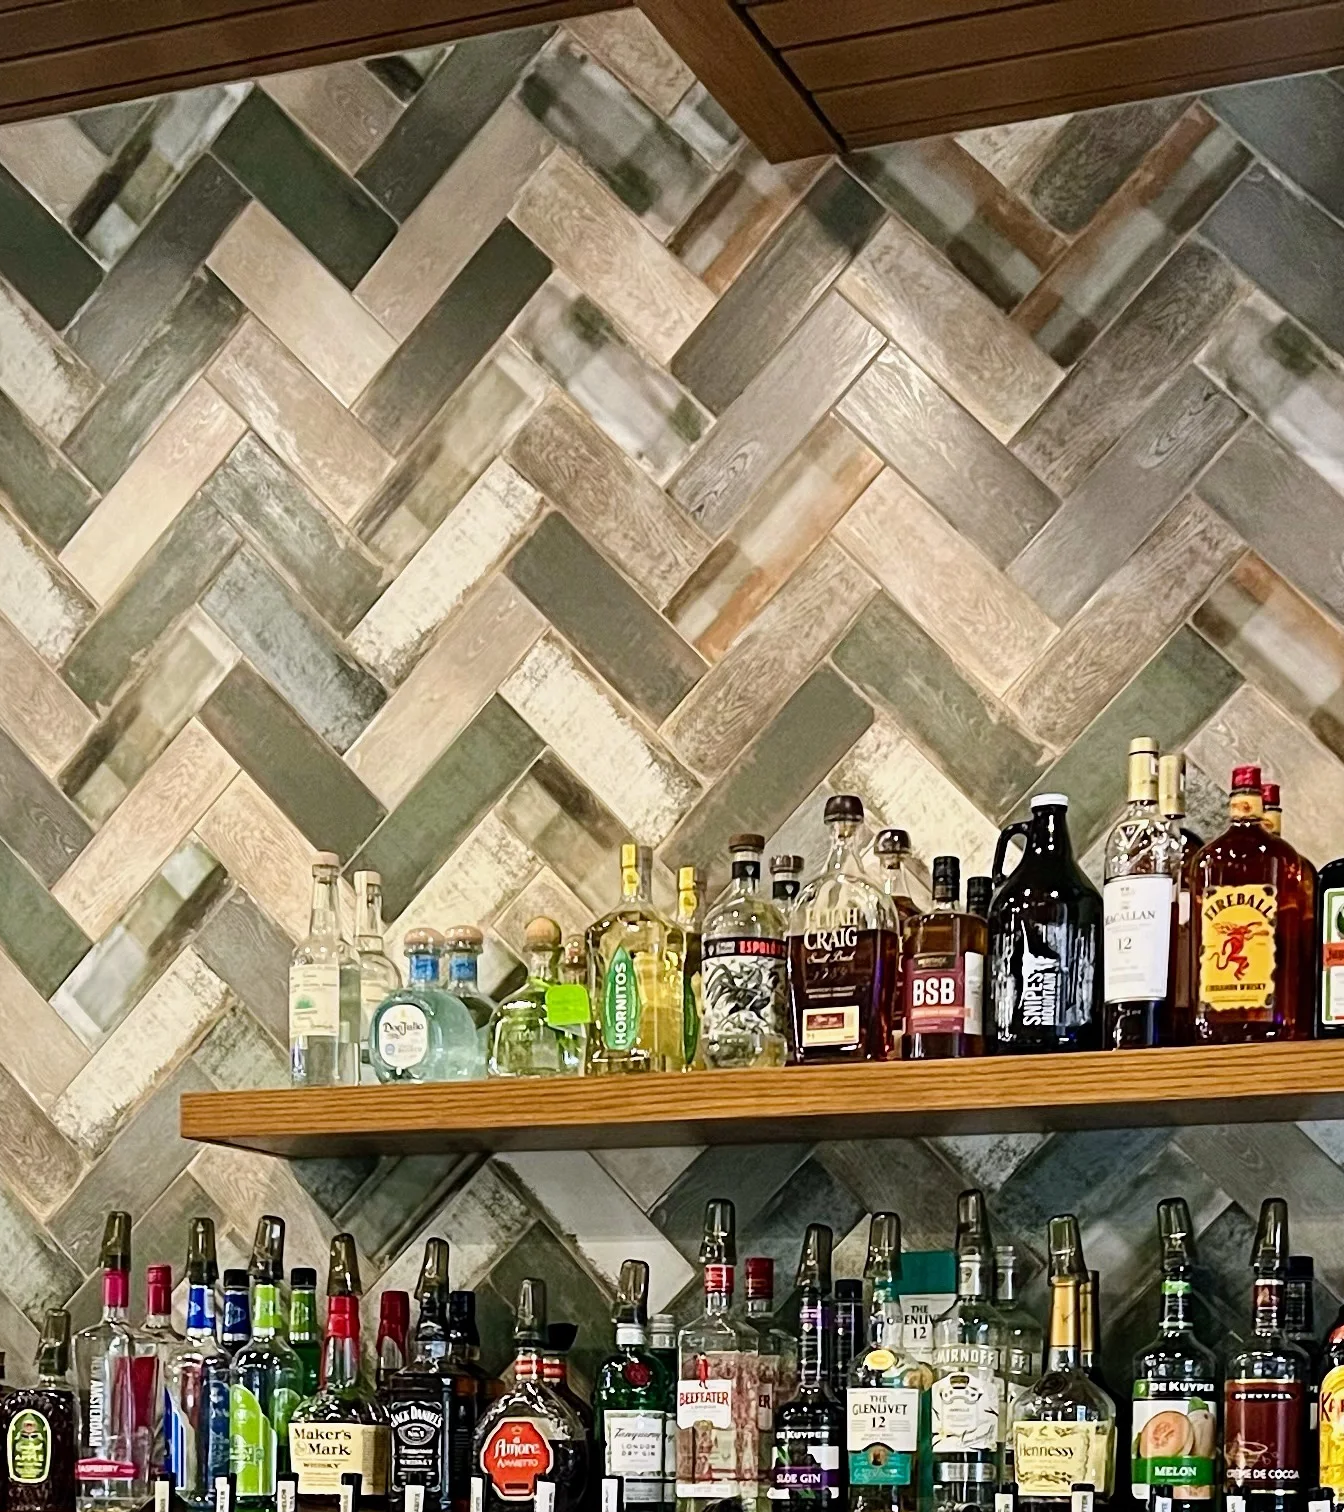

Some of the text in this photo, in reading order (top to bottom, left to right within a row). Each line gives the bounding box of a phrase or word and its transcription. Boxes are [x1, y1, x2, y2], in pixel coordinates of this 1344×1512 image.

[1204, 893, 1273, 921] FIREBALL
[804, 928, 858, 950] CRAIG
[1118, 938, 1132, 951] 12
[913, 977, 955, 1006] BSB
[1023, 972, 1043, 1026] SNIPES
[1042, 972, 1056, 1026] MOUNTAIN
[615, 962, 626, 1045] HORNITOS
[911, 1305, 928, 1314] THE
[913, 1327, 927, 1339] 12
[680, 1391, 729, 1407] BEEFEATER
[870, 1395, 887, 1403] THE
[89, 1380, 104, 1447] AMSTERDAM
[852, 1403, 908, 1416] GLENLIVET
[391, 1409, 410, 1428] JACK
[870, 1417, 886, 1428] 12
[294, 1428, 352, 1441] Maker's
[308, 1444, 351, 1456] Mark
[495, 1439, 540, 1459] Amore
[1019, 1443, 1074, 1459] Hennessy
[1154, 1467, 1197, 1477] MELON
